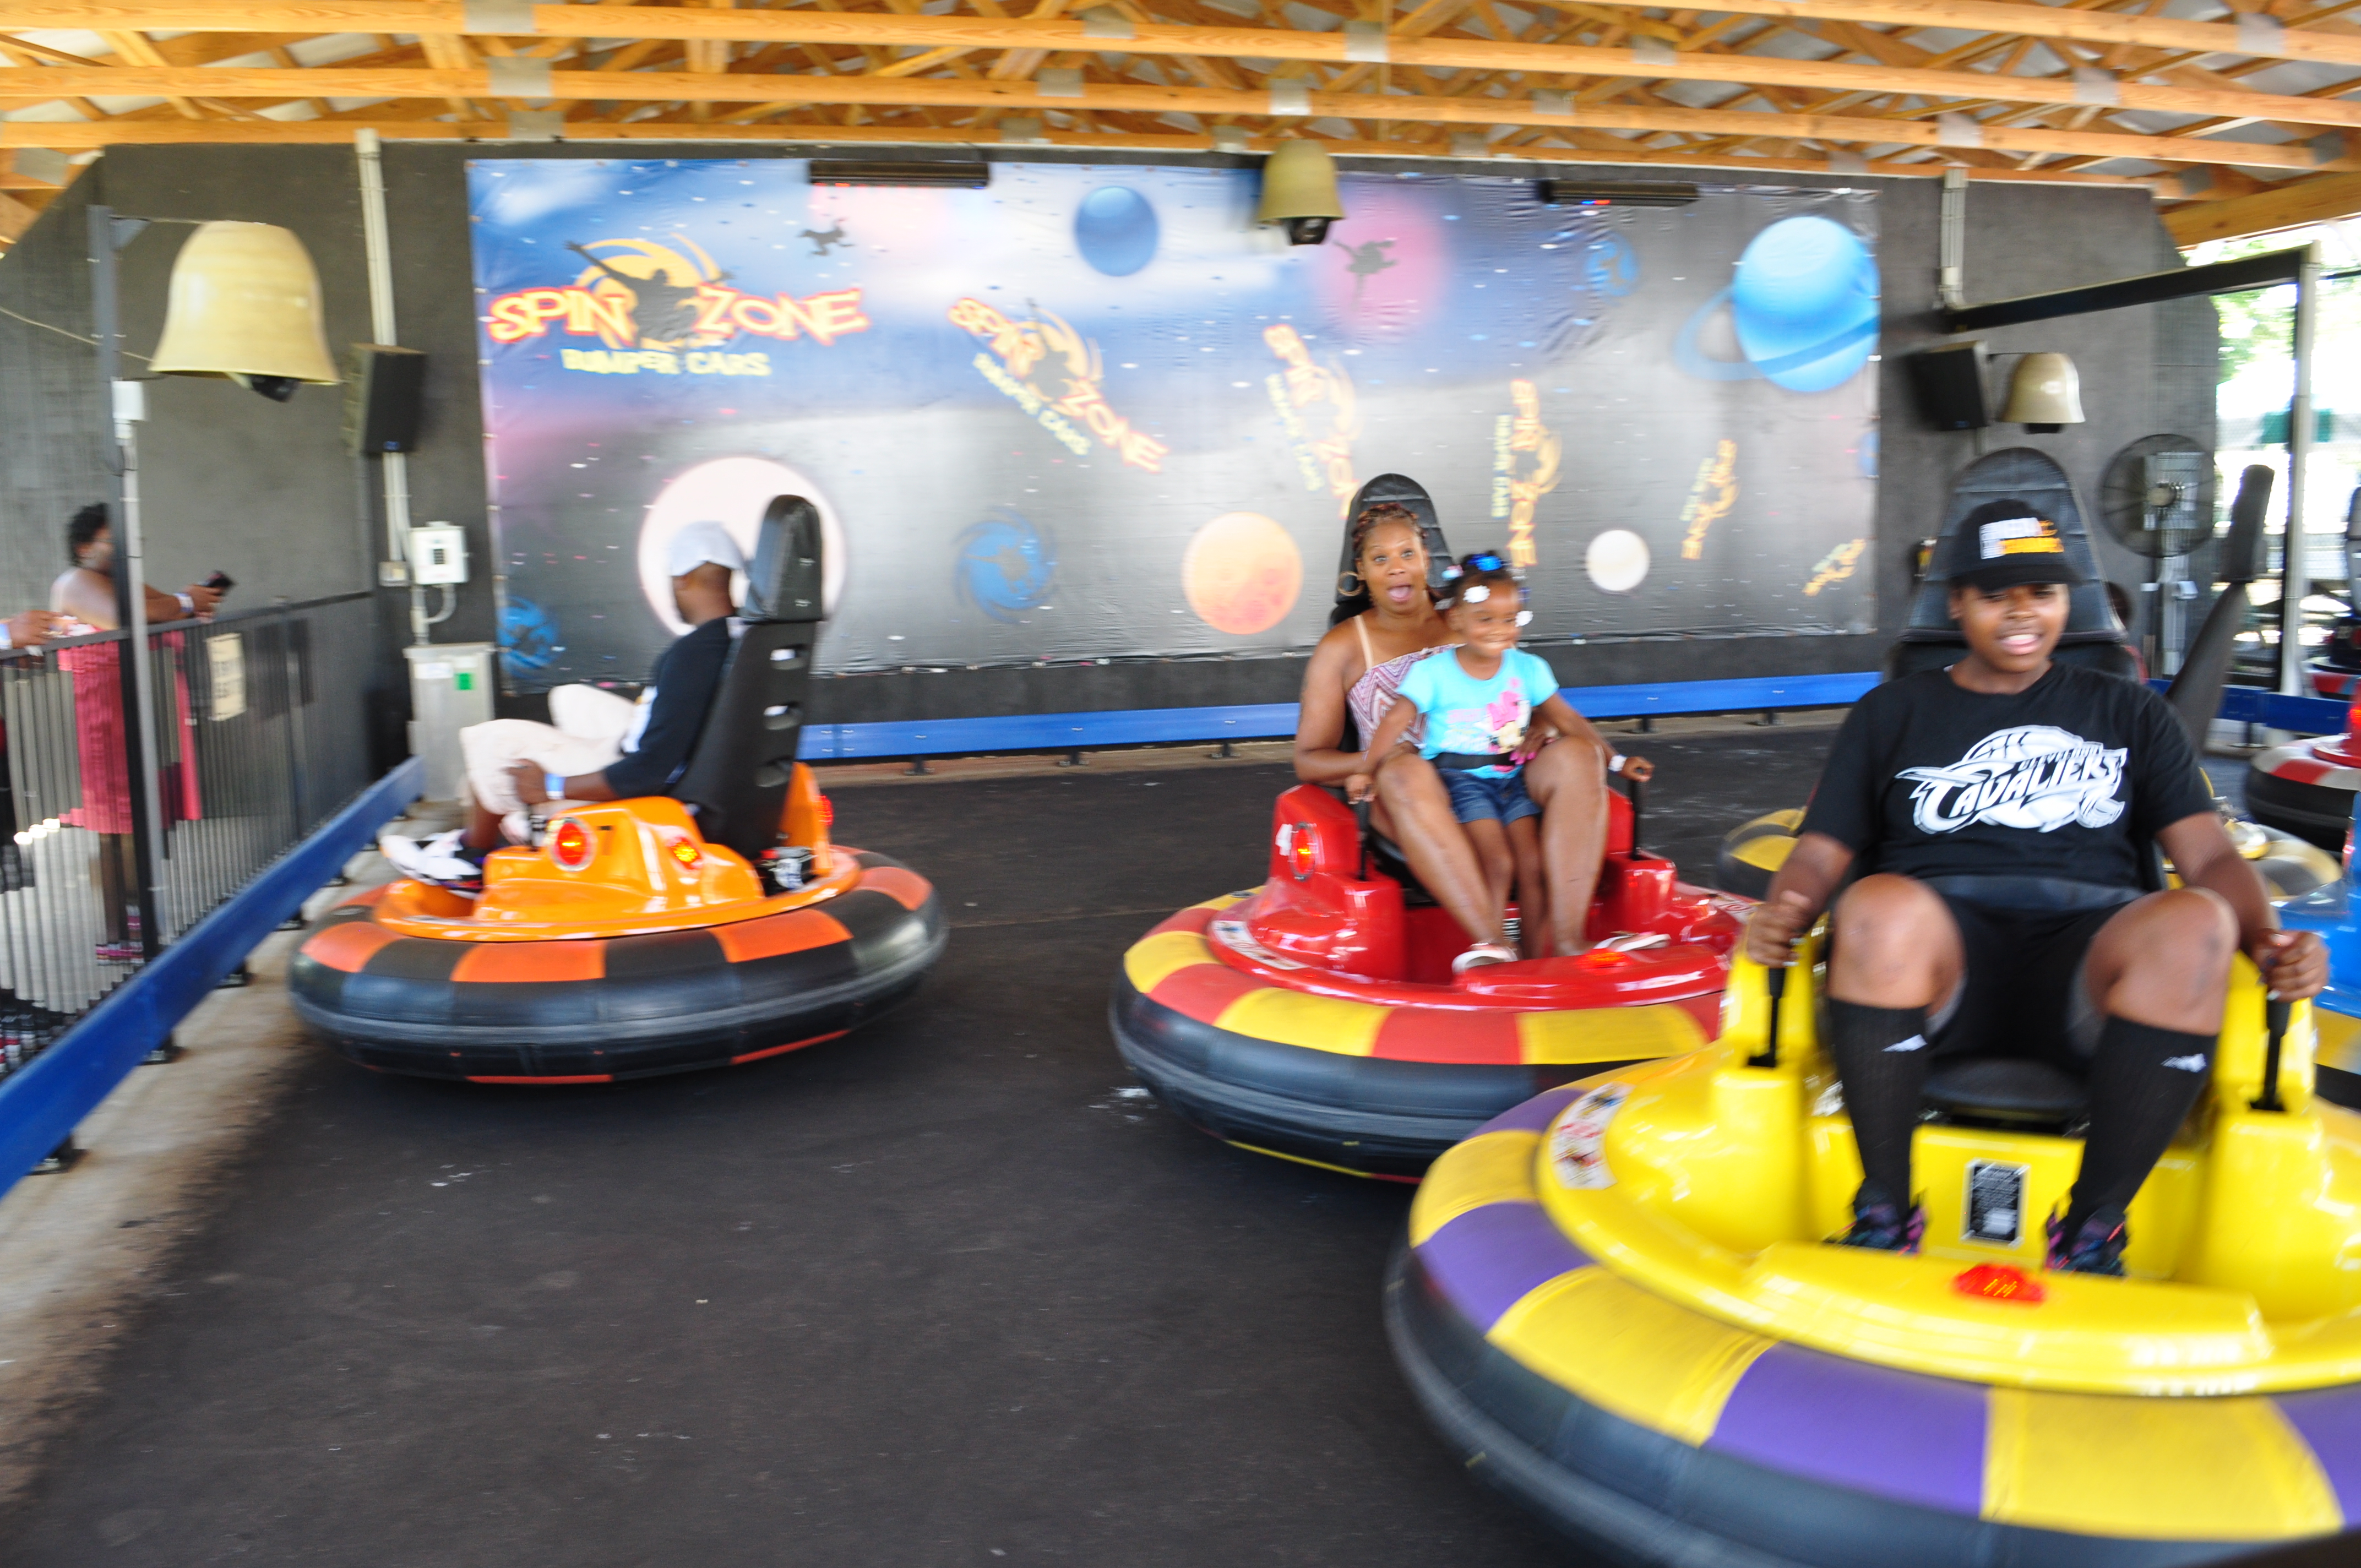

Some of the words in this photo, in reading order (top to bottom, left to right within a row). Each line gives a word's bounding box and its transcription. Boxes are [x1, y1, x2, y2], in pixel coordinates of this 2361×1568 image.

[488, 285, 638, 347] SPIN
[692, 281, 872, 346] ZONE
[684, 351, 773, 377] CARS
[1059, 377, 1171, 473] ZONE
[1312, 439, 1361, 520] ZON
[1895, 747, 2129, 832] CAVALIERS
